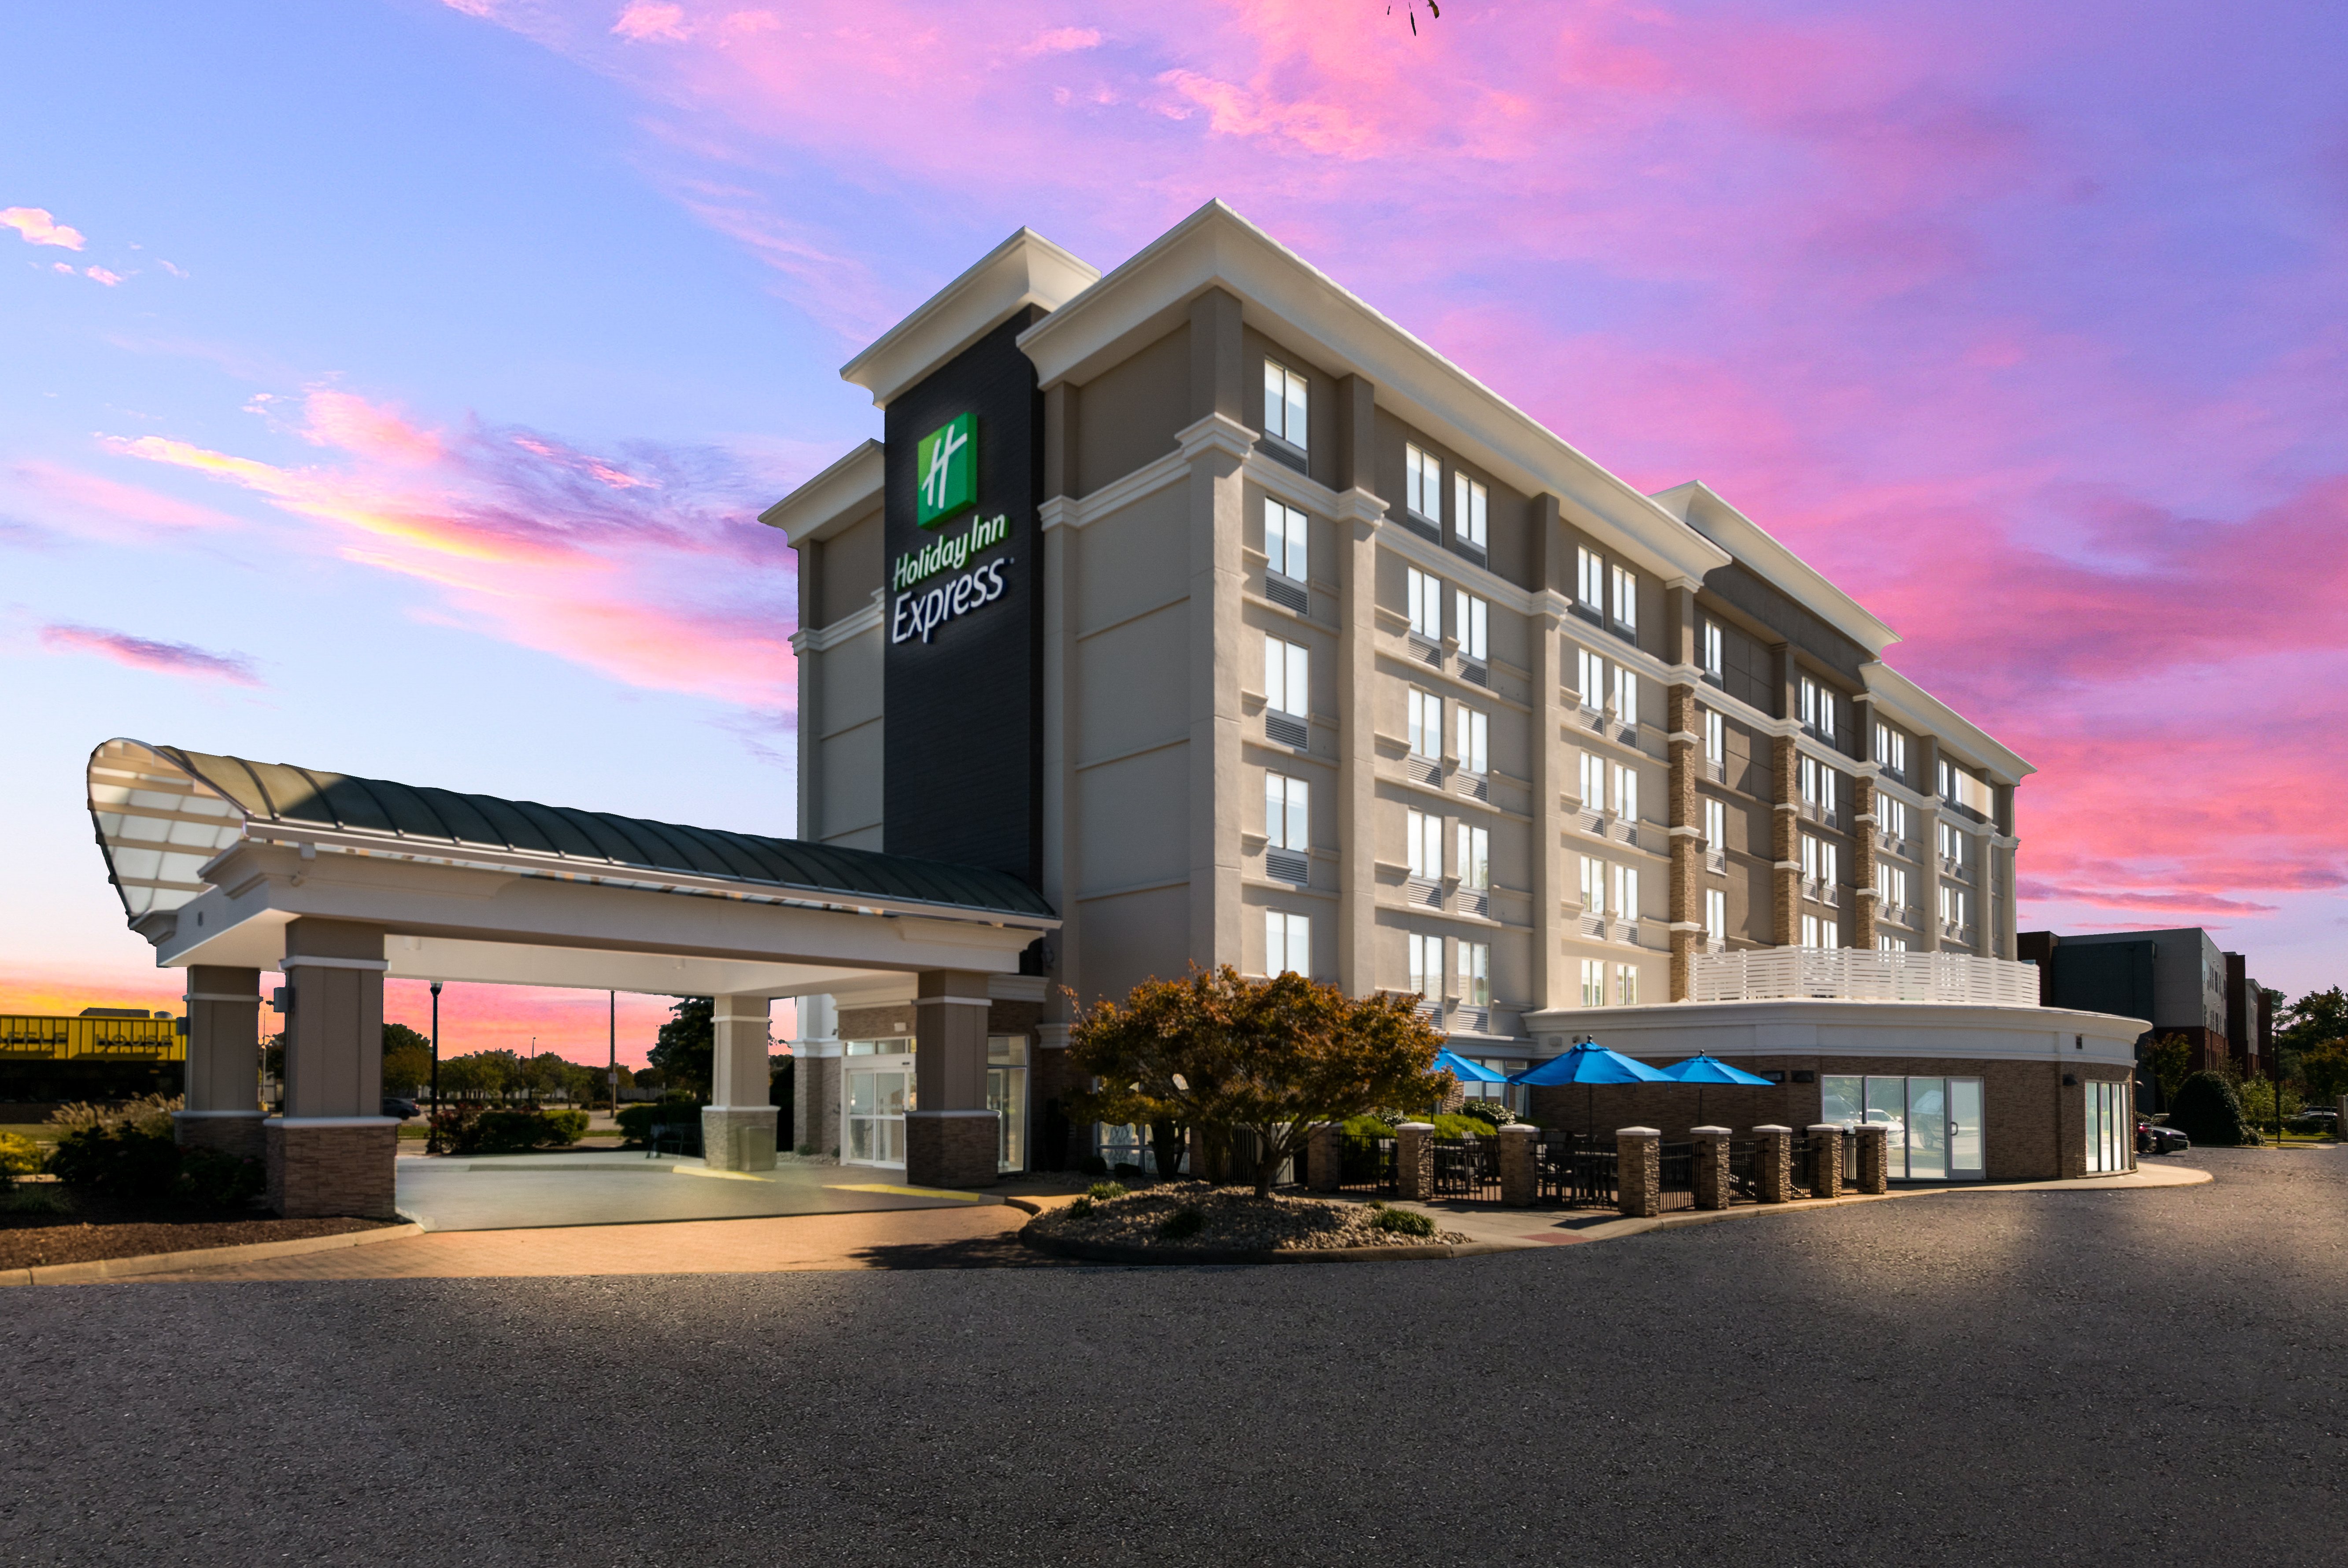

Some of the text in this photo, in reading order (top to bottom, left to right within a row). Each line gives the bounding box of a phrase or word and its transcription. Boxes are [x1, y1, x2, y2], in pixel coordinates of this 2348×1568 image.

[893, 513, 1006, 592] Holiday Inn
[892, 557, 1006, 644] Express
[0, 1032, 174, 1047] FFLE HOUSE
